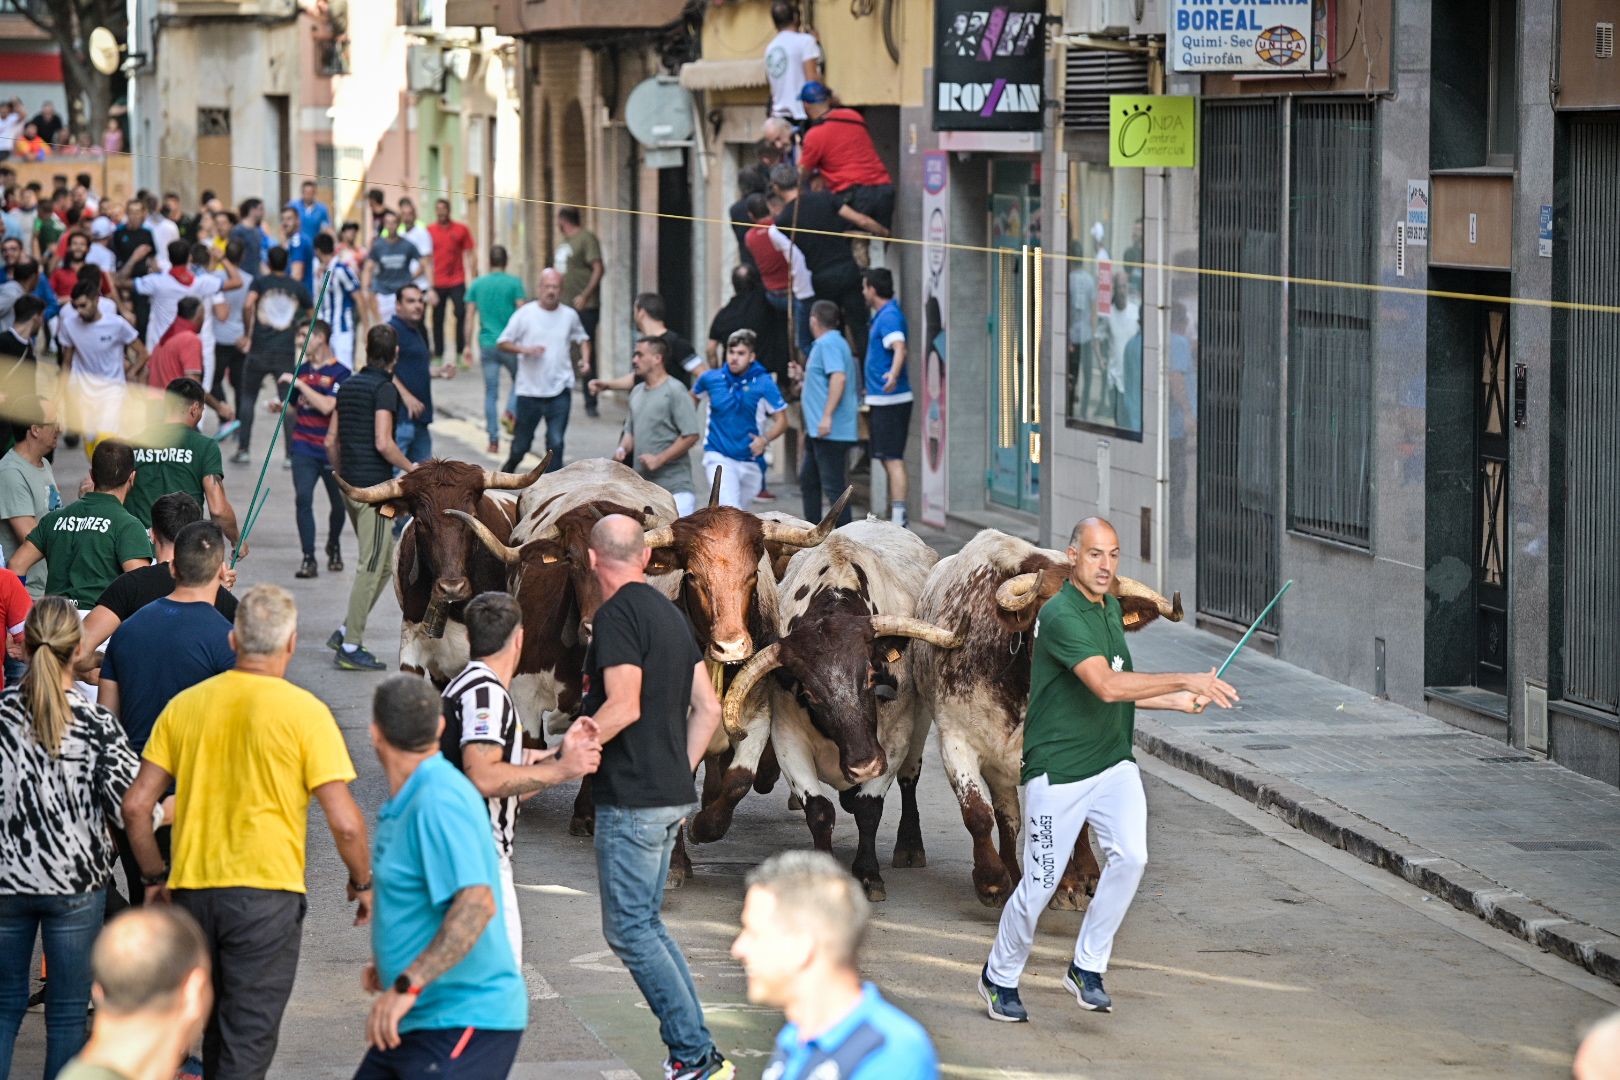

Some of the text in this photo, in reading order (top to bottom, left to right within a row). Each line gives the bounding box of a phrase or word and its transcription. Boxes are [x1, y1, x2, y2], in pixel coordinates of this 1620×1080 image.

[1177, 9, 1263, 31] BOREAL
[1182, 52, 1243, 66] Quirofán
[53, 516, 111, 533] PASTORES
[1040, 815, 1055, 889] ESPORTS LIZONDO
